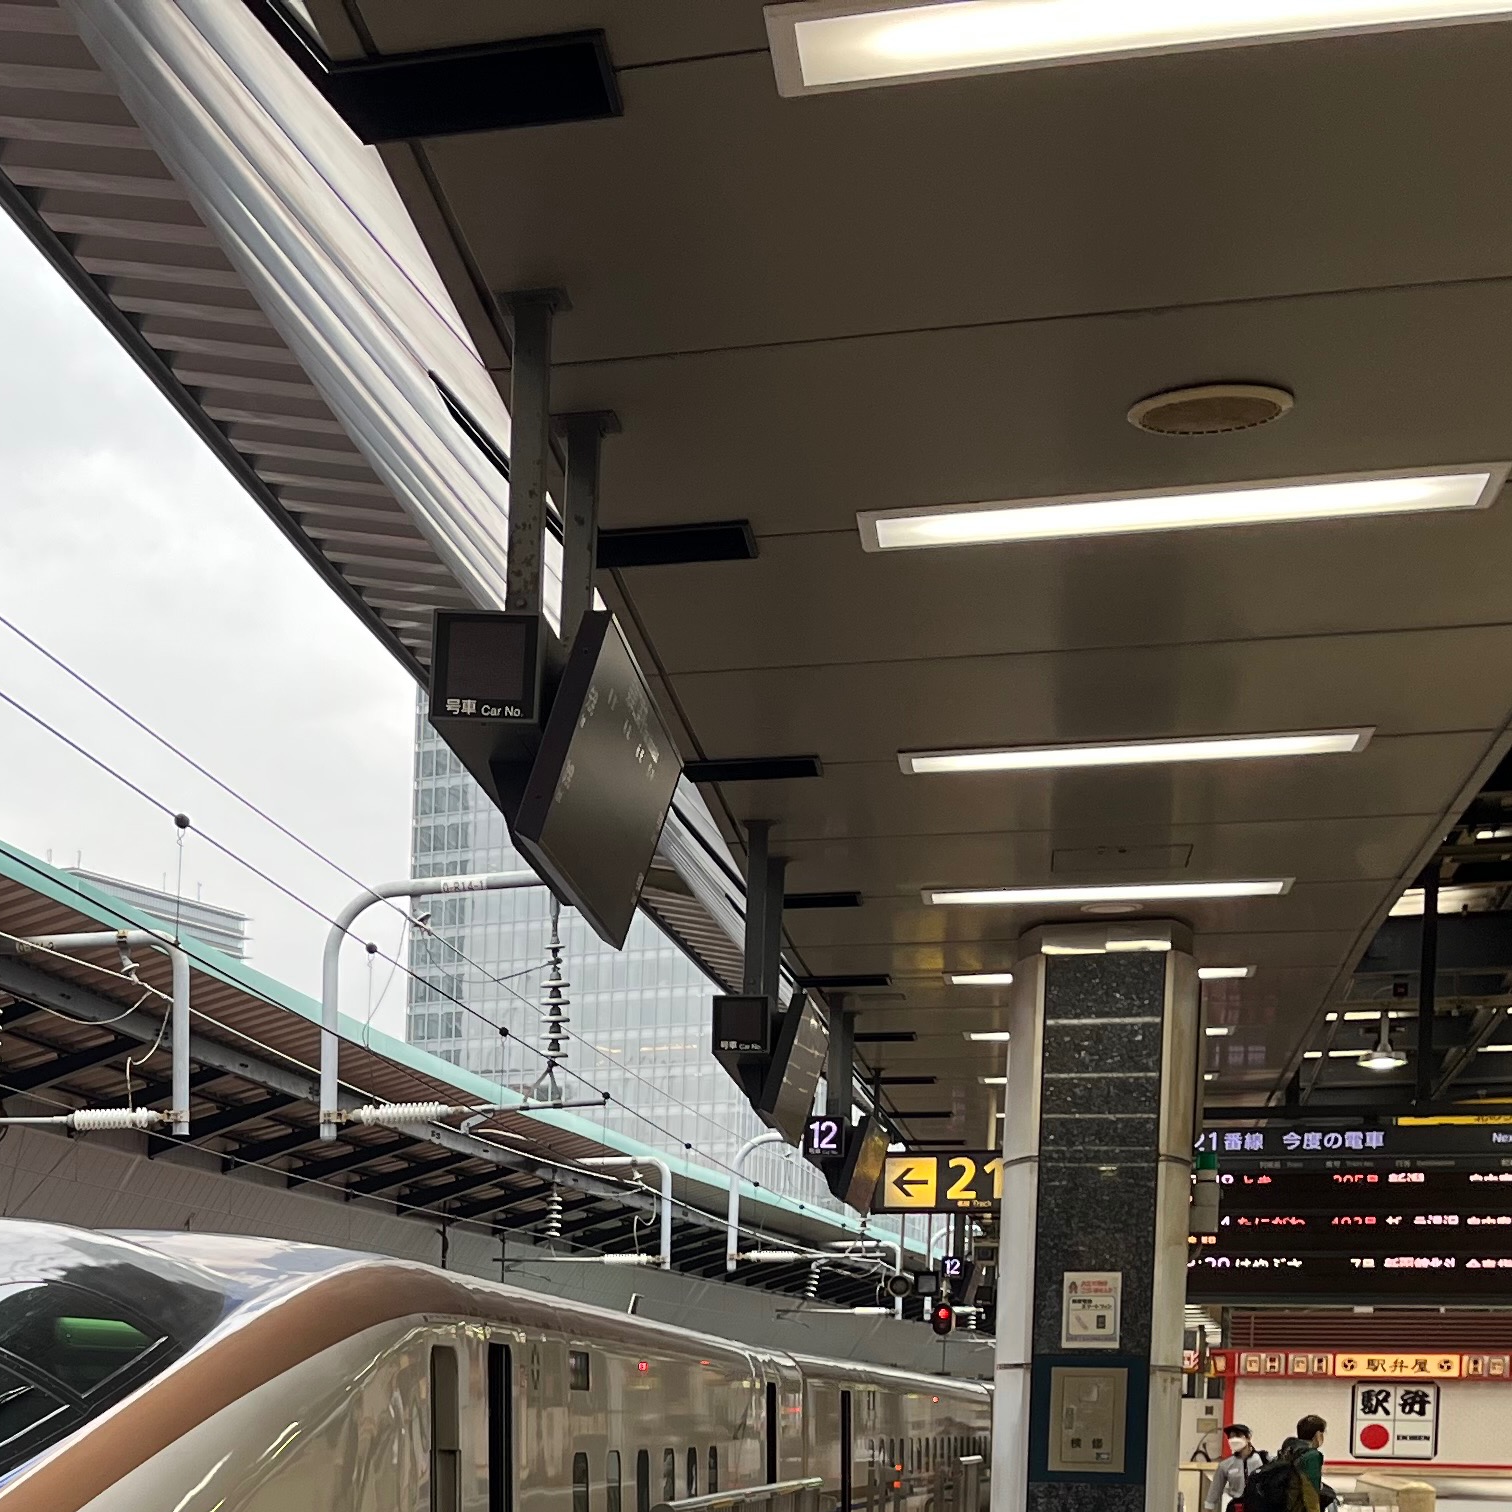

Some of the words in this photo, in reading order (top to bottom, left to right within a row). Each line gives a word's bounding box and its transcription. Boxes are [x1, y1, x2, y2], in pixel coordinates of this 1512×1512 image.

[446, 698, 477, 715] 号車
[481, 705, 501, 716] Car
[504, 706, 524, 717] No.
[809, 1121, 838, 1149] 12
[1283, 1131, 1385, 1150] 今度の電車
[946, 1157, 1004, 1199] 21
[944, 1259, 961, 1275] 12
[1366, 1357, 1430, 1373] 駅弁屋
